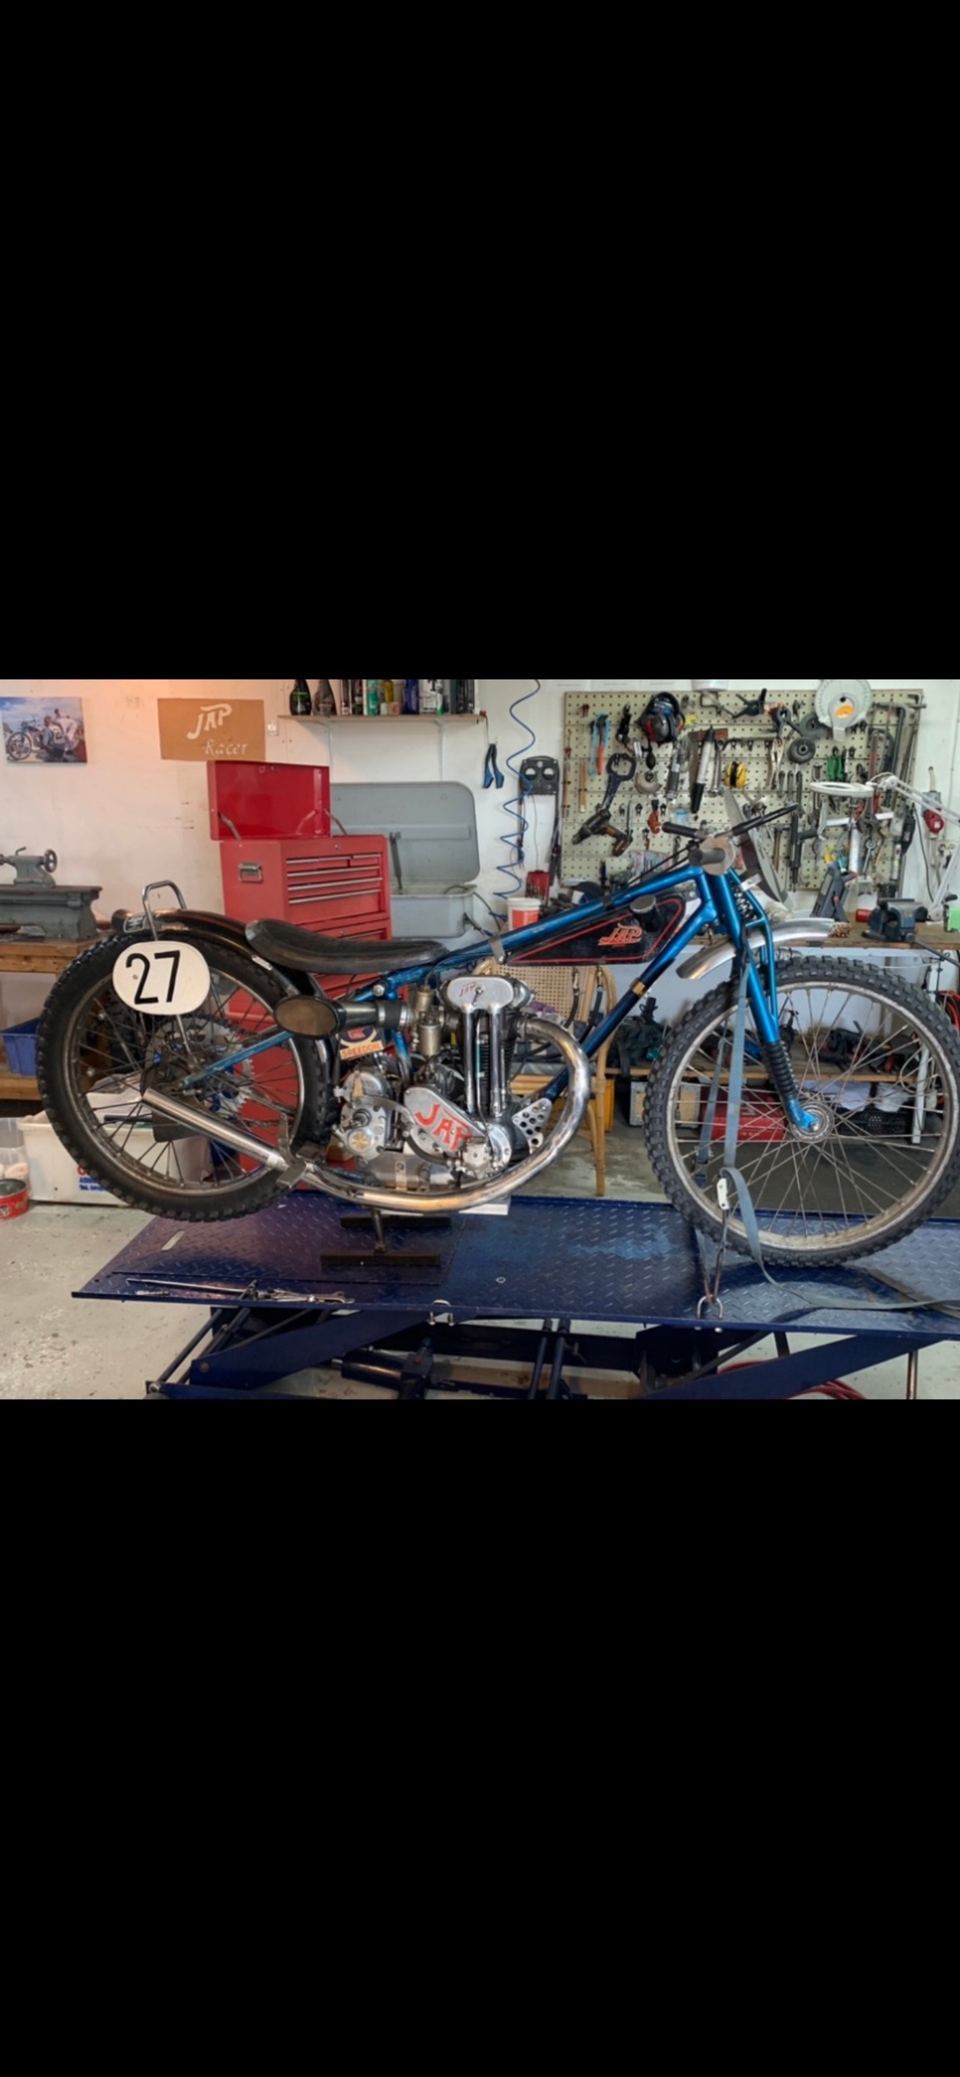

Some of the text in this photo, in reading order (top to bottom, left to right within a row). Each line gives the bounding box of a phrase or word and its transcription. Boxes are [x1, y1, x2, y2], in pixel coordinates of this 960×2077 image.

[187, 703, 232, 740] JAP
[205, 739, 248, 757] Racer
[125, 950, 181, 1005] 27
[414, 1103, 473, 1153] JAP
